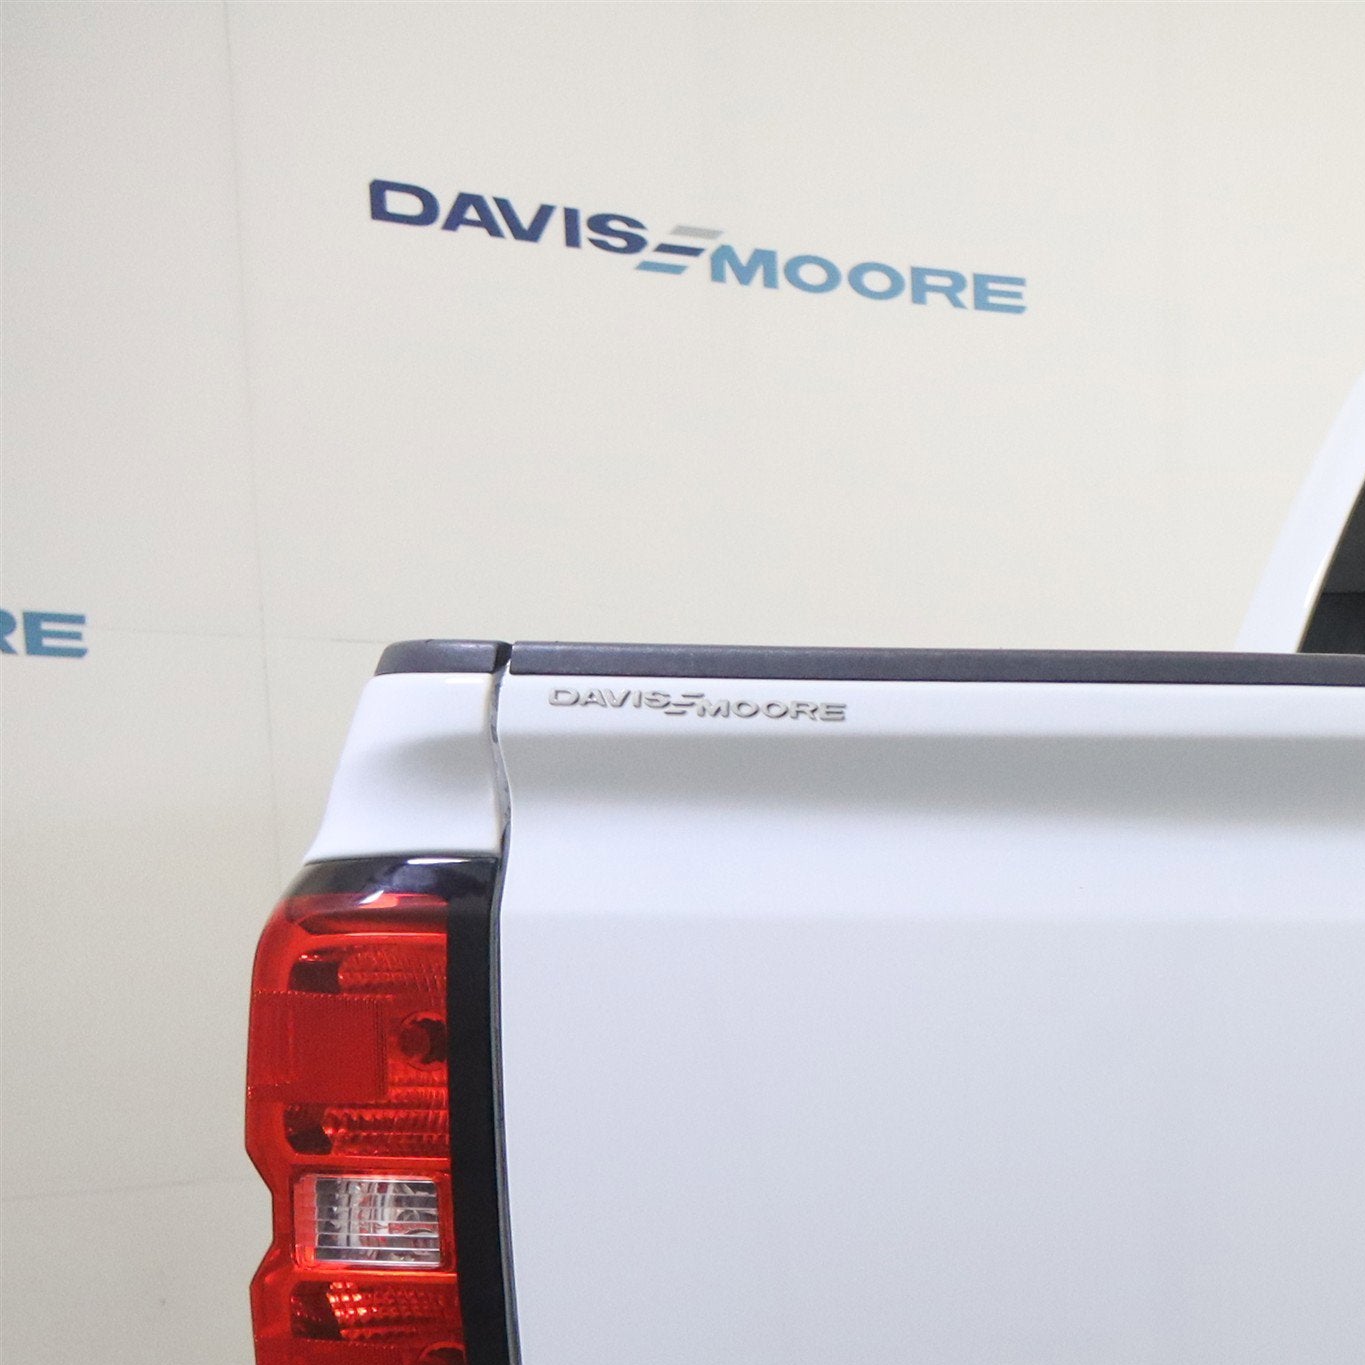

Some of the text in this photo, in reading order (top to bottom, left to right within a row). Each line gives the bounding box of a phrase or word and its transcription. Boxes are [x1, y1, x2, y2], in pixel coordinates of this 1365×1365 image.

[368, 178, 1027, 314] DAVIS MOORE
[549, 688, 848, 722] DAVIS MOORE
